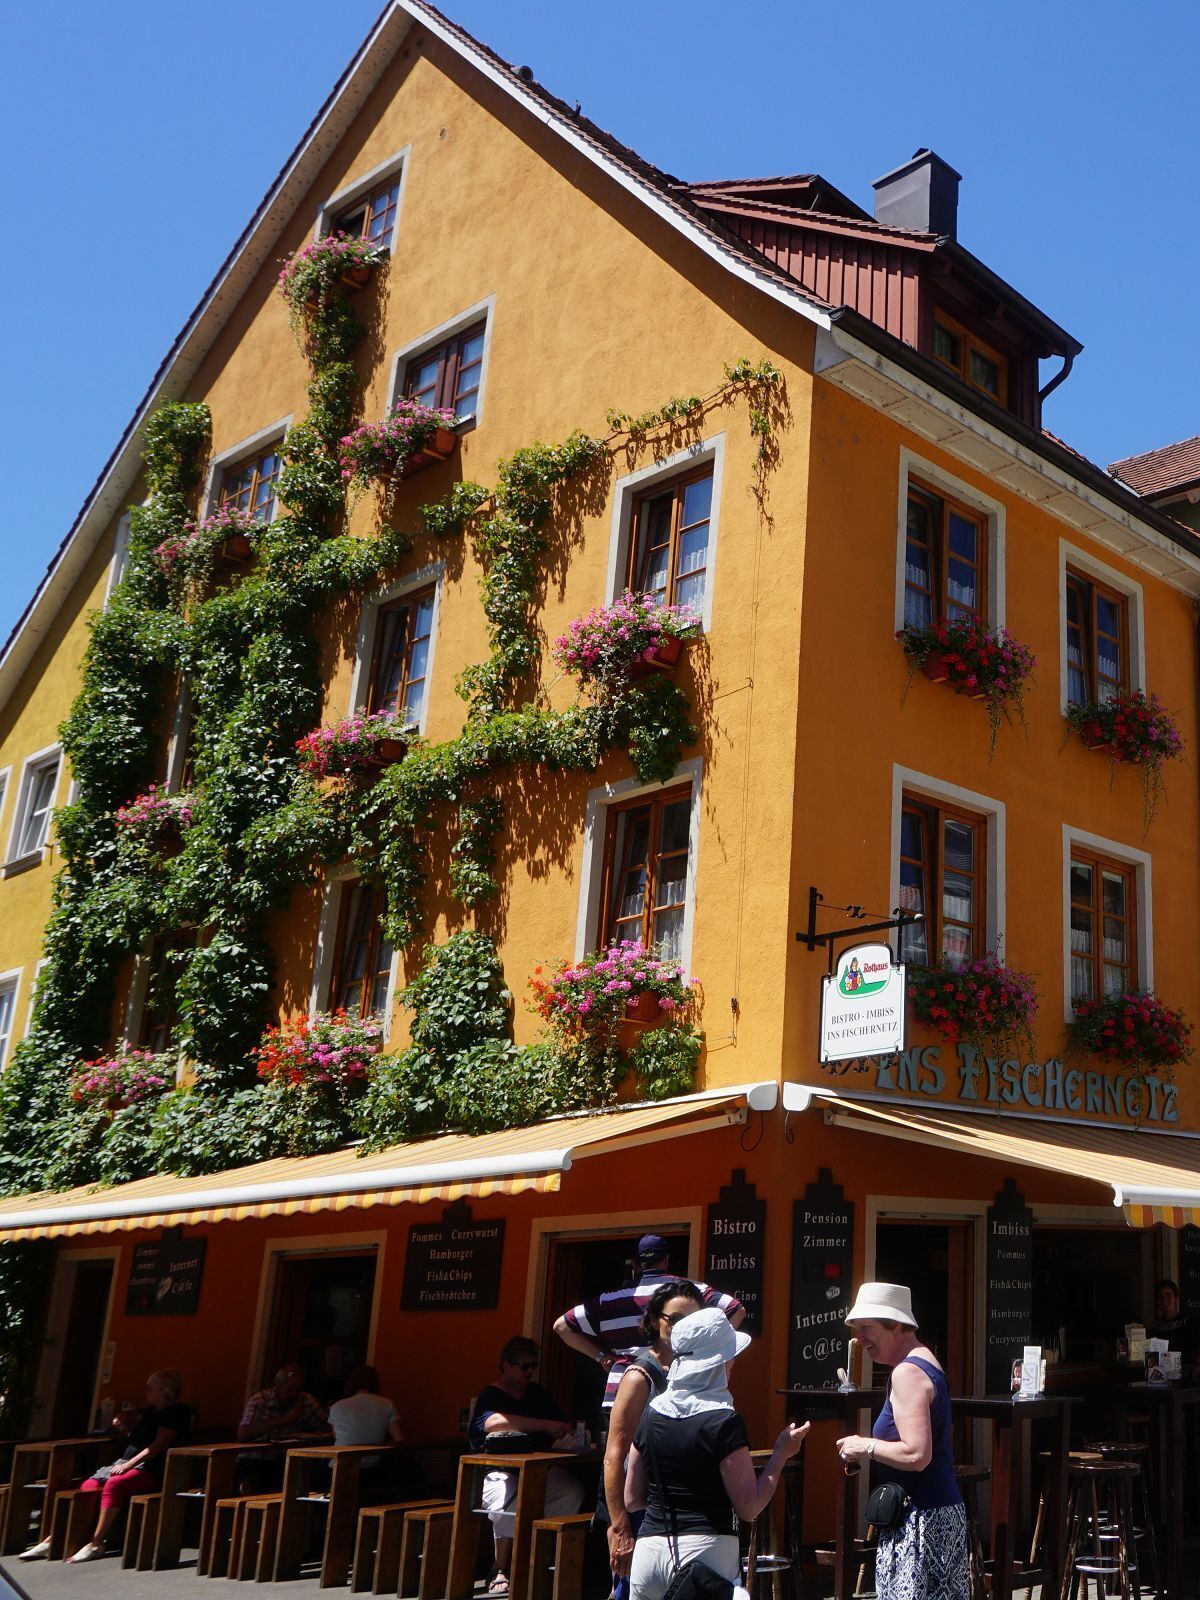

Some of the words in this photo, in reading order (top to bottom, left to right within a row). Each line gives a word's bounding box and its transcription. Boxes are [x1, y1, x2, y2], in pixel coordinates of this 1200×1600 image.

[863, 962, 889, 973] Rothaus
[831, 1012, 861, 1026] BISTRO
[866, 1007, 895, 1021] IMBISS
[827, 1027, 841, 1040] INS
[842, 1021, 898, 1038] FISCHERNETZ
[804, 1211, 849, 1224] Pension
[713, 1218, 757, 1235] Bistro
[992, 1220, 1030, 1236] Imbiss
[411, 1231, 443, 1243] Pommes
[451, 1227, 499, 1241] Currywurst
[803, 1235, 848, 1247] Zimmer
[429, 1248, 474, 1260] Hamburger
[996, 1249, 1026, 1259] Pommes
[169, 1257, 199, 1273] Internet
[710, 1252, 756, 1271] Imbiss
[426, 1269, 473, 1282] Fish&Chips
[990, 1279, 1032, 1291] Fish&Chips
[733, 1289, 757, 1301] Cino
[795, 1305, 850, 1330] Internet
[991, 1309, 1031, 1321] Hamburger
[989, 1334, 1031, 1346] Currywurst
[802, 1337, 843, 1361] C@fe
